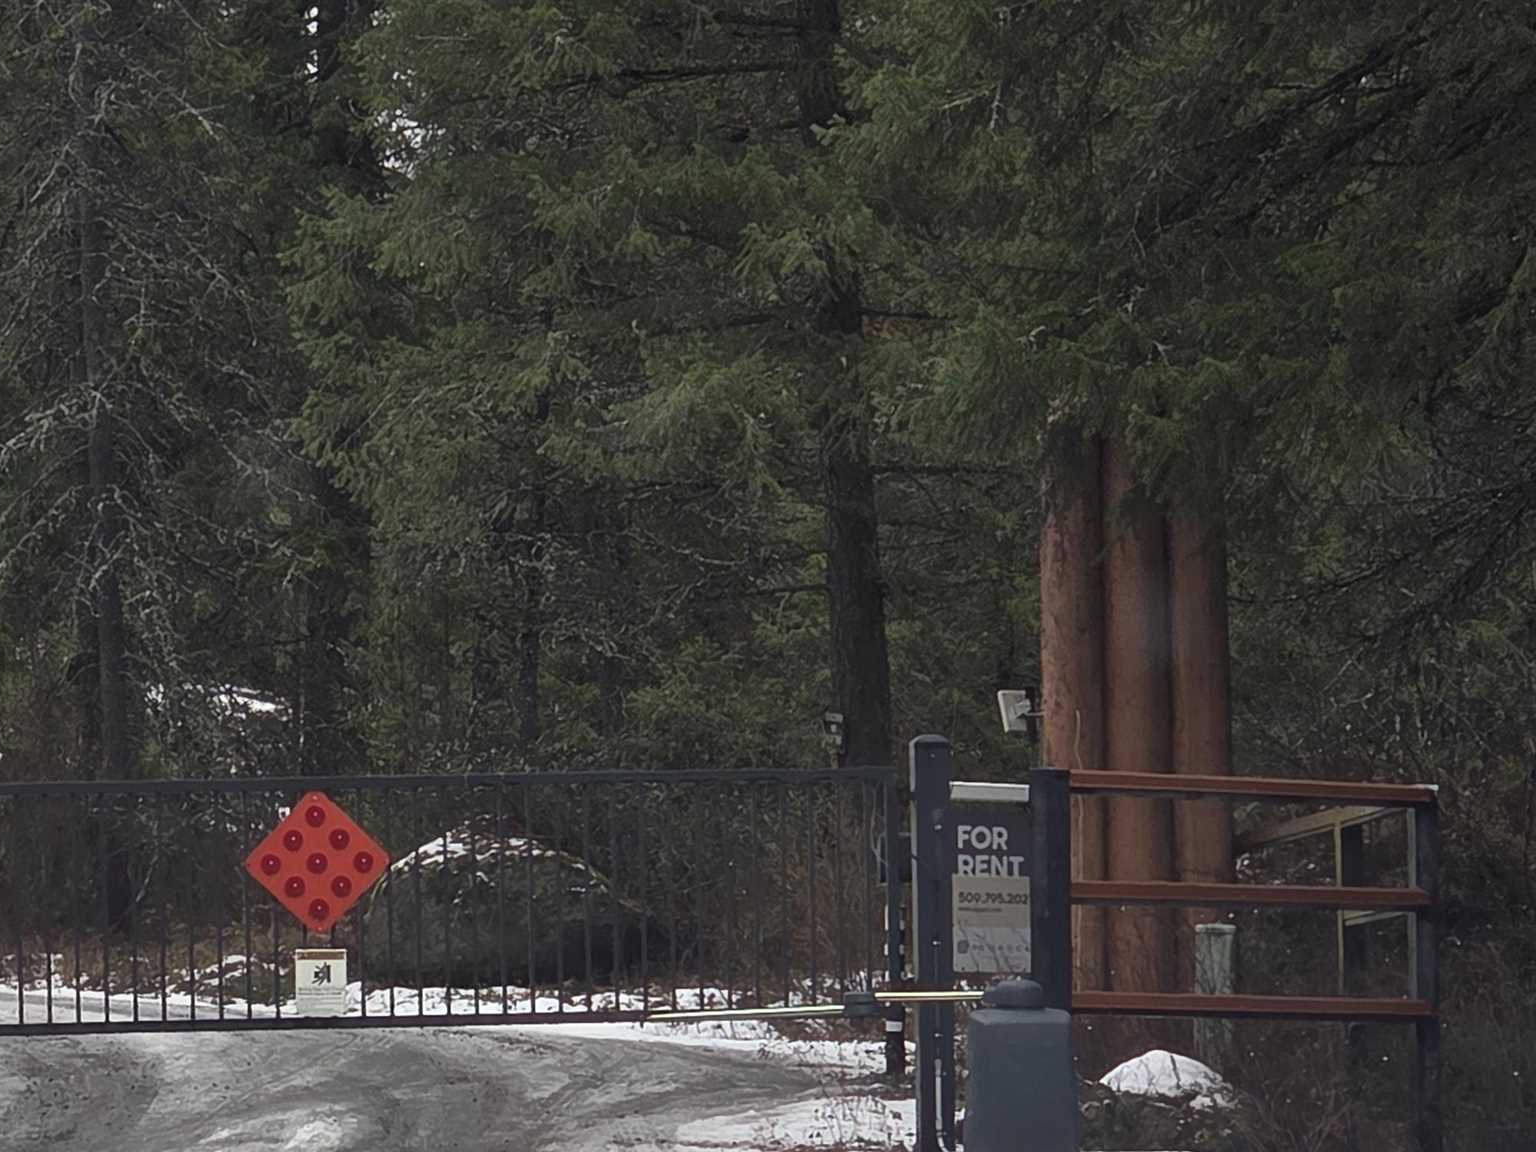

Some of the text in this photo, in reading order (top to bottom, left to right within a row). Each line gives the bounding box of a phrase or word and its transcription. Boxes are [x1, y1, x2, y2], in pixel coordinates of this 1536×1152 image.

[957, 825, 1008, 850] FOR
[957, 854, 1025, 877] RENT
[958, 891, 1029, 905] 509.795.202
